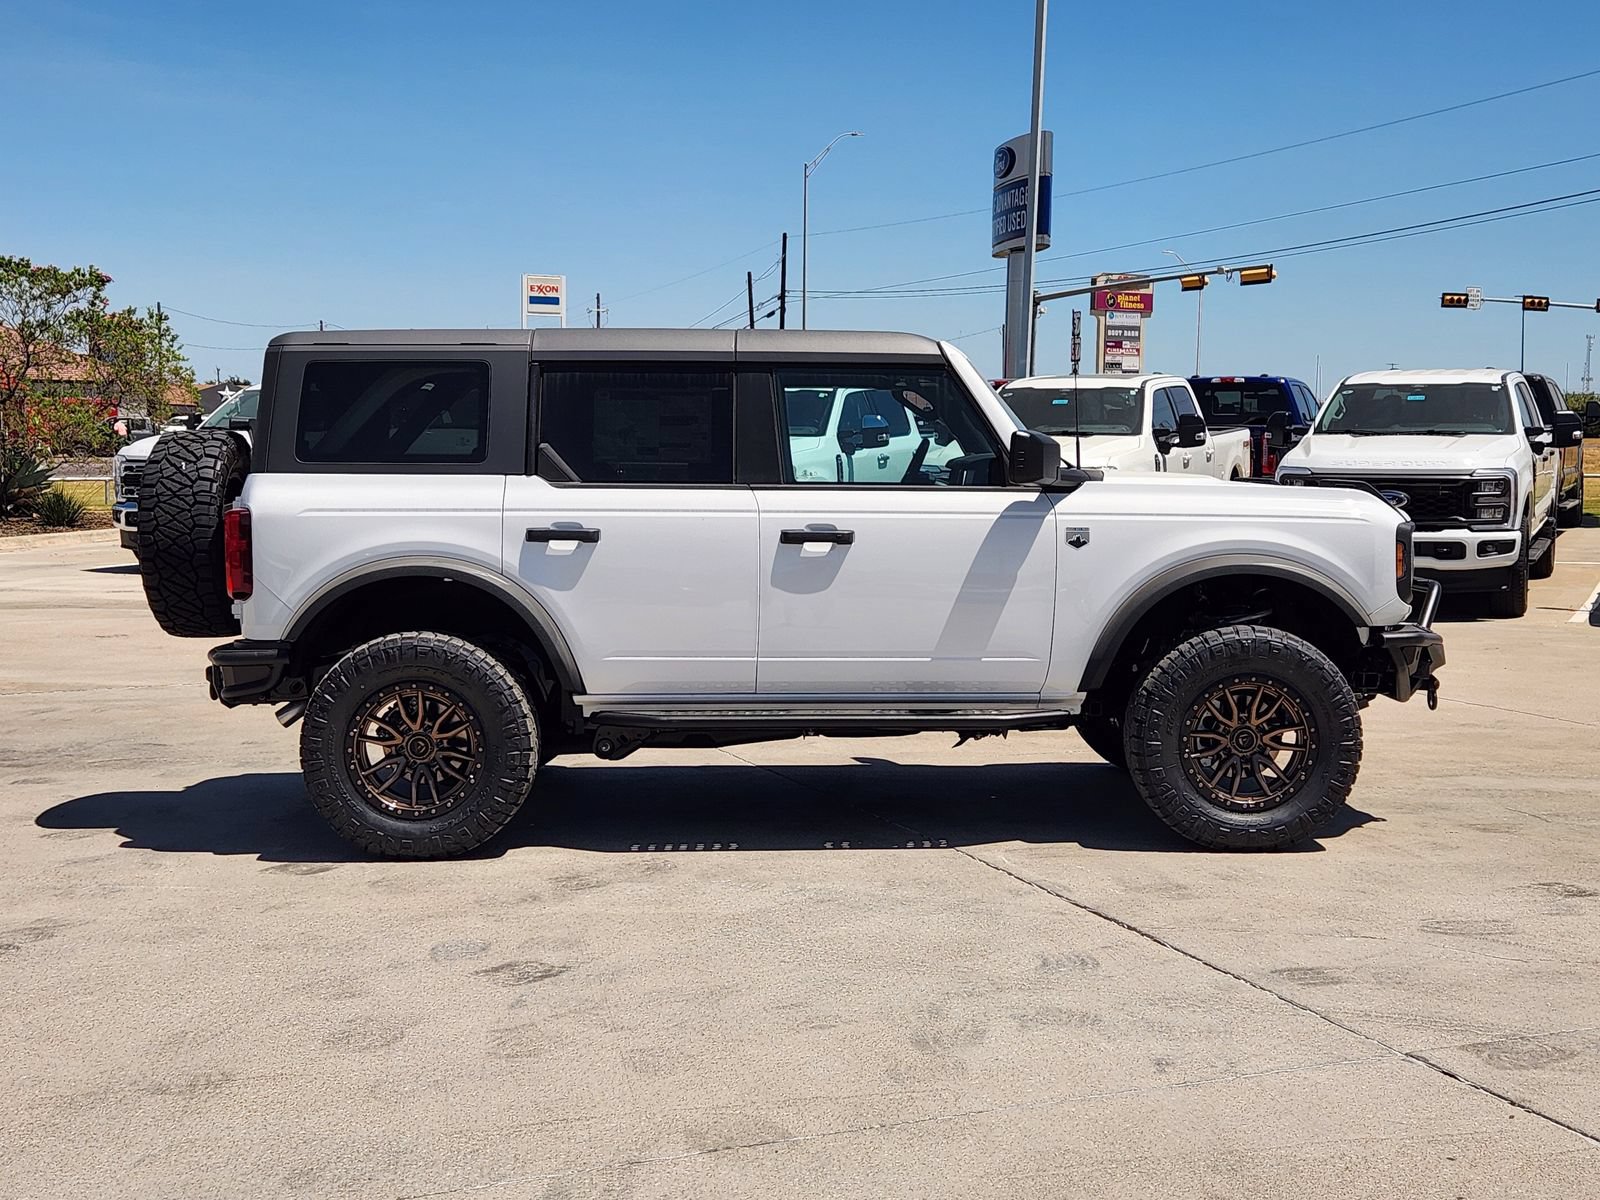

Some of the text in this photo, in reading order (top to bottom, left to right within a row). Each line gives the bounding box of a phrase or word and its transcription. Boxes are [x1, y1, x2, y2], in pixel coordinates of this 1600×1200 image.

[1007, 210, 1027, 232] USED
[529, 284, 559, 295] EXXON
[1117, 294, 1141, 302] planet
[1120, 300, 1145, 309] fitness
